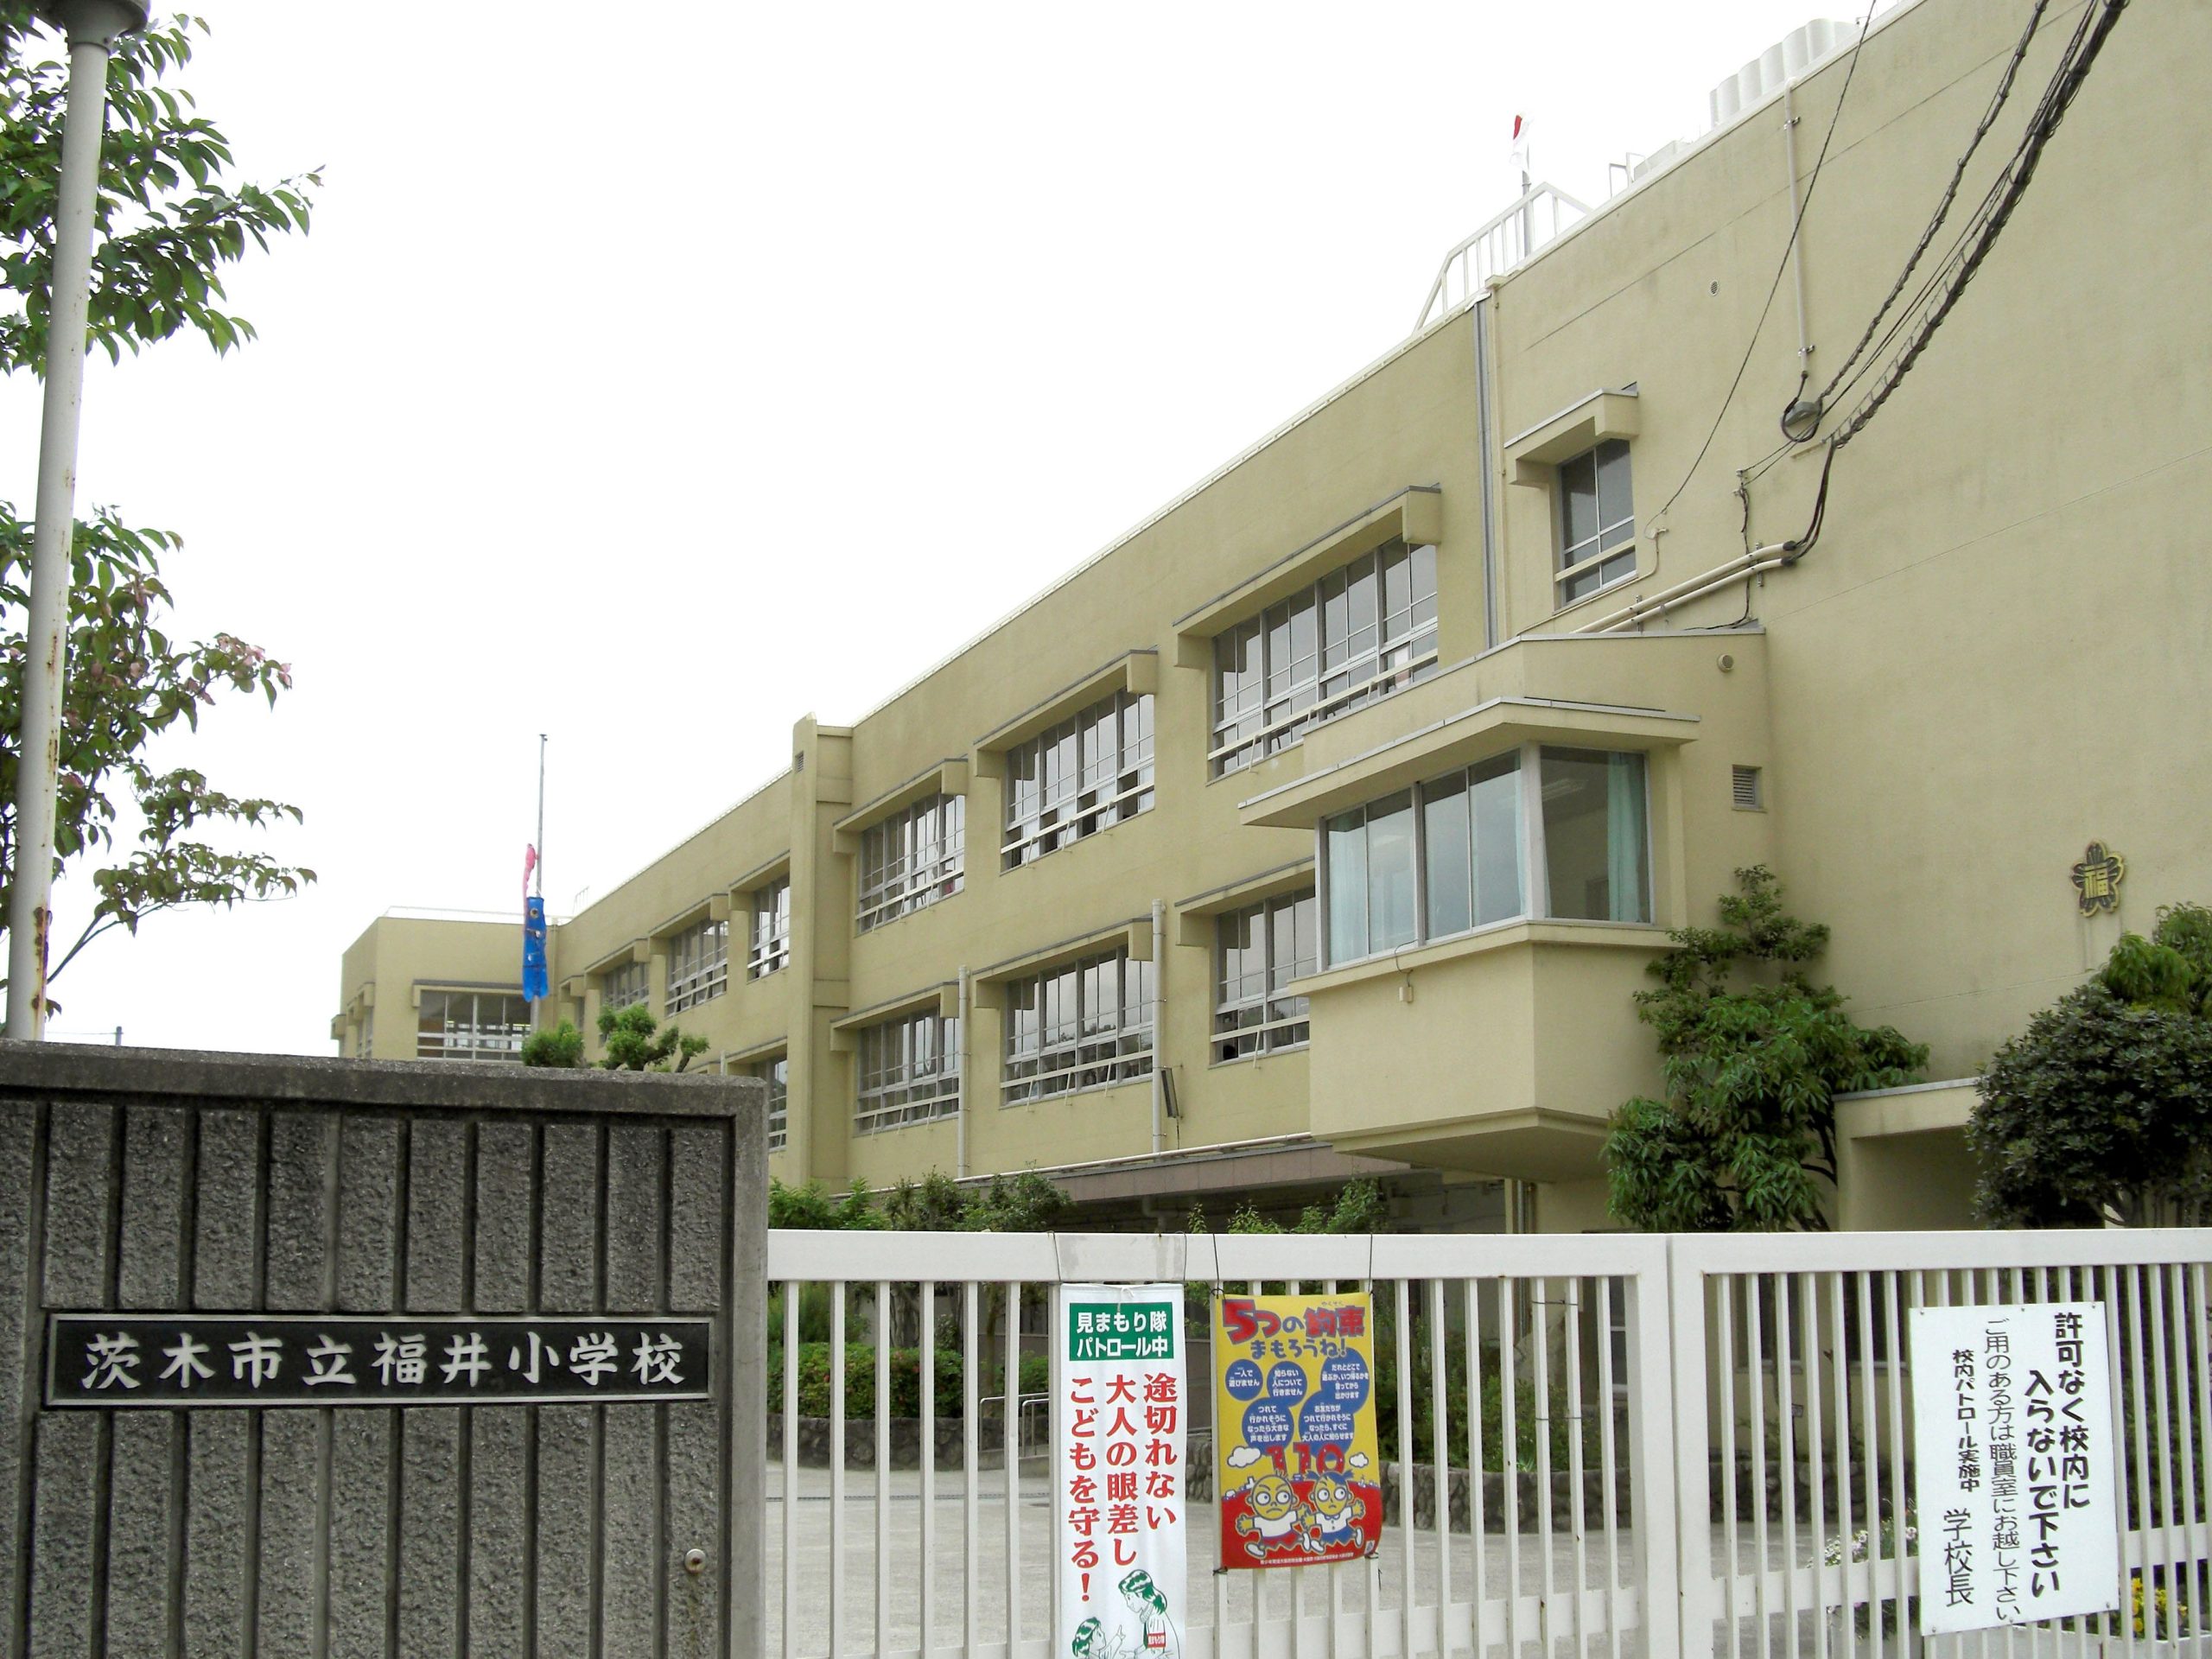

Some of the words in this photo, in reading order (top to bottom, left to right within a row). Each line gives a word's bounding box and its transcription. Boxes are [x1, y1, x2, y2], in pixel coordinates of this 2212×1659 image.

[81, 1331, 687, 1389] 茨木市立福井小学校
[1077, 1311, 1166, 1333] 見まもり隊
[1077, 1336, 1167, 1357] パトロール中
[1222, 1299, 1365, 1344] 5つの約束
[1105, 1374, 1138, 1567] 大人の眼差し
[1143, 1373, 1178, 1530] 途切れない
[1266, 1442, 1345, 1477] 110
[1953, 1349, 1980, 1492] 校内パトロール実施中
[1985, 1318, 2020, 1621] ご用のある方は職員室にお越し下さい
[2054, 1313, 2090, 1509] 許可なく校内に
[2024, 1370, 2060, 1598] 入らないで下さい
[1943, 1509, 1974, 1606] 学校長
